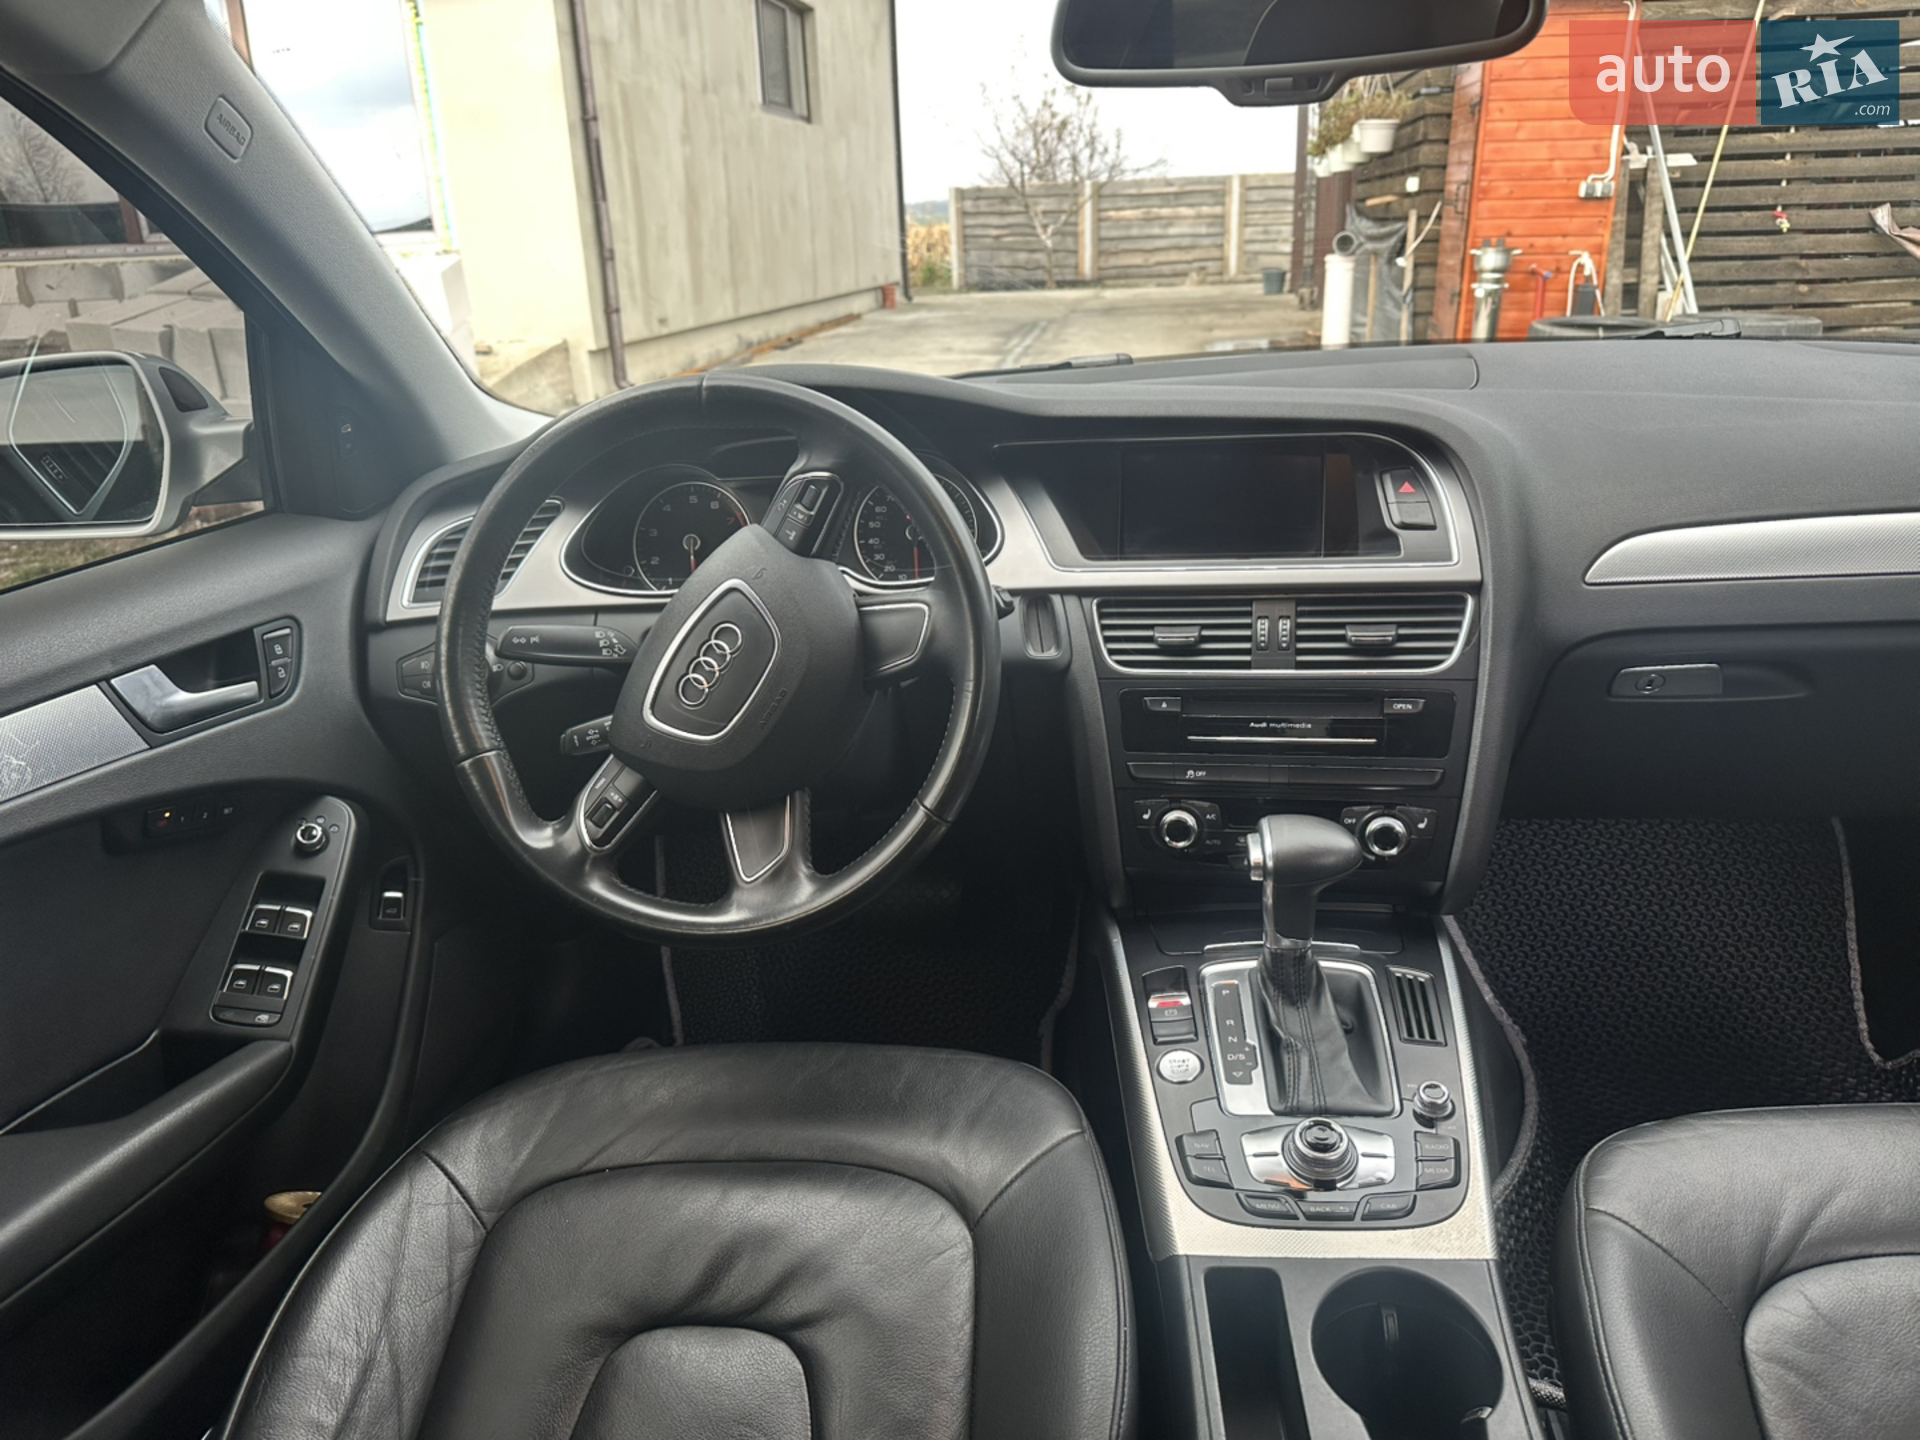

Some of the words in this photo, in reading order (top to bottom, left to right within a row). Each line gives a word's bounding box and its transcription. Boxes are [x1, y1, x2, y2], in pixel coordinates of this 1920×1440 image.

[216, 113, 246, 147] AIRBAG
[689, 495, 699, 504] 5
[662, 504, 672, 512] 4
[710, 501, 720, 510] 6
[727, 516, 736, 526] 7
[868, 521, 881, 529] 50
[648, 528, 658, 537] 3
[650, 556, 660, 565] 2
[873, 553, 885, 561] 30
[1249, 721, 1268, 729] Audi
[1269, 721, 1312, 729] multimedia
[1343, 817, 1357, 825] OFF
[1226, 1019, 1236, 1027] R
[1228, 1035, 1238, 1043] N
[1227, 1053, 1246, 1061] D/S
[1310, 1205, 1331, 1213] BACK
